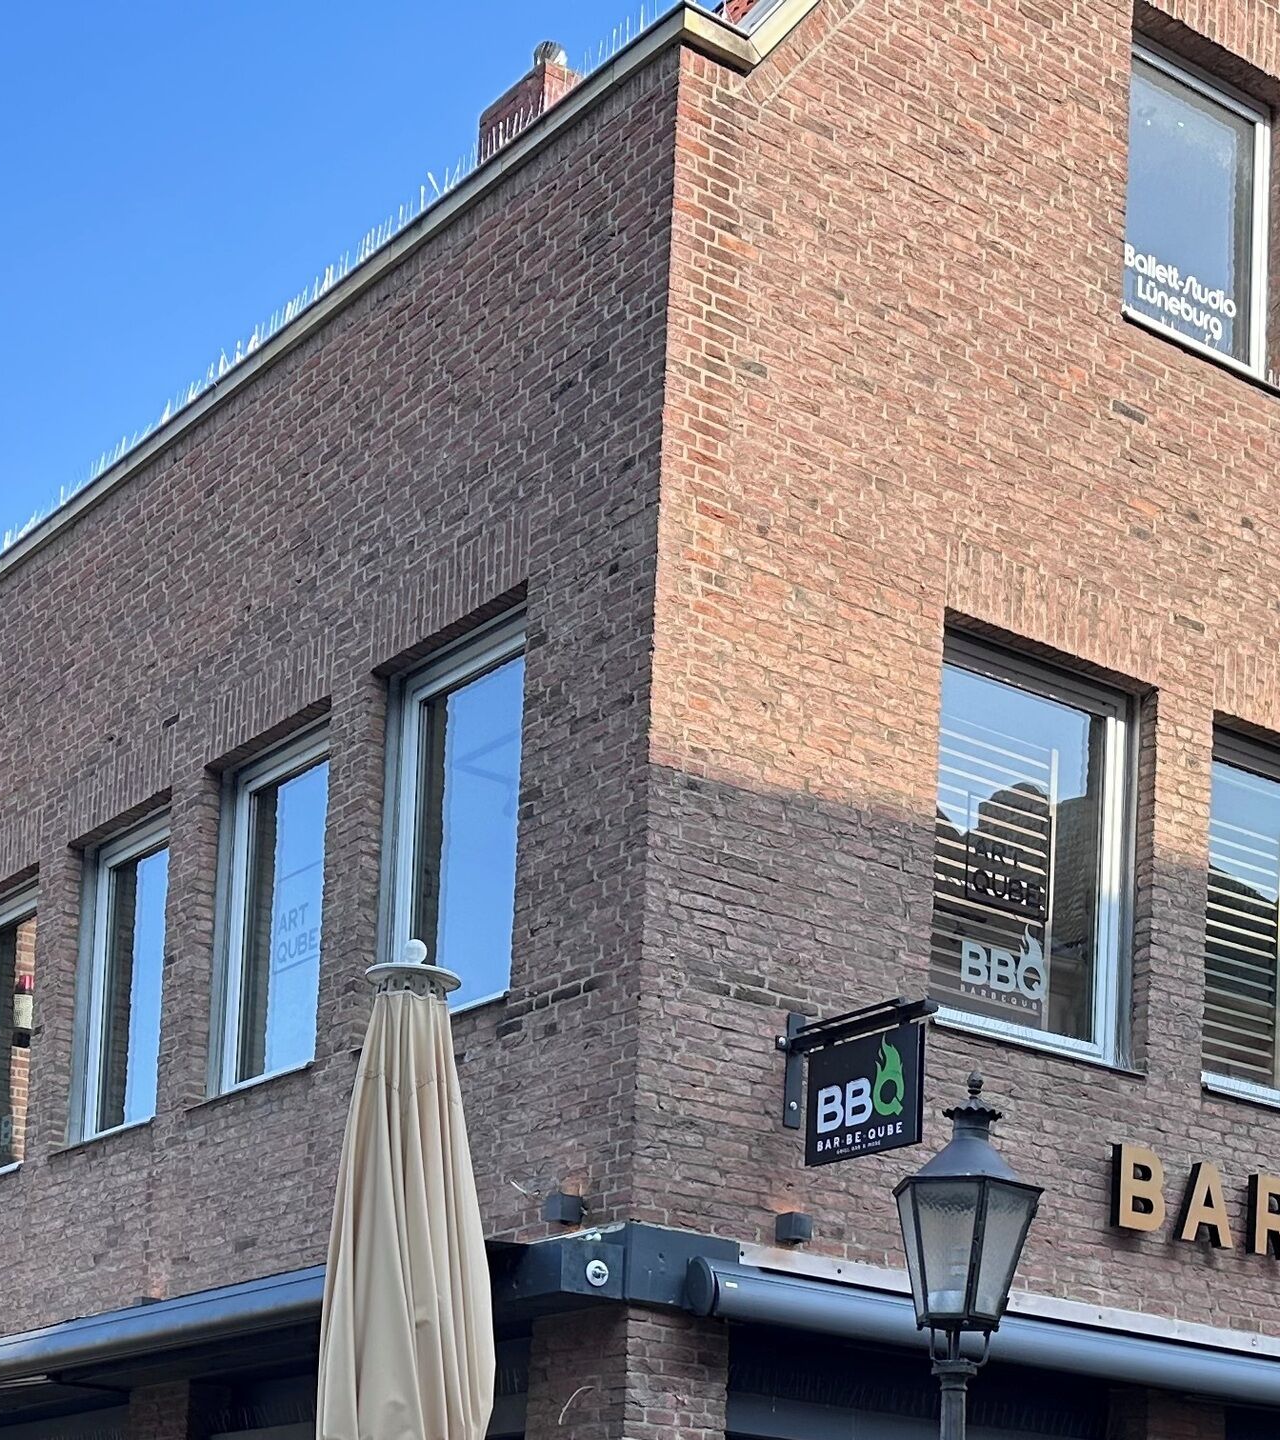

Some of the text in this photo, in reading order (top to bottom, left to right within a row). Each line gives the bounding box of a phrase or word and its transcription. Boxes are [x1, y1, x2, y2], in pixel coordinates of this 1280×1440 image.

[1136, 274, 1223, 340] Lüneburg
[277, 902, 309, 935] ART
[277, 927, 319, 963] QUBE
[960, 924, 1047, 1002] BBQ
[816, 1033, 905, 1134] BBQ
